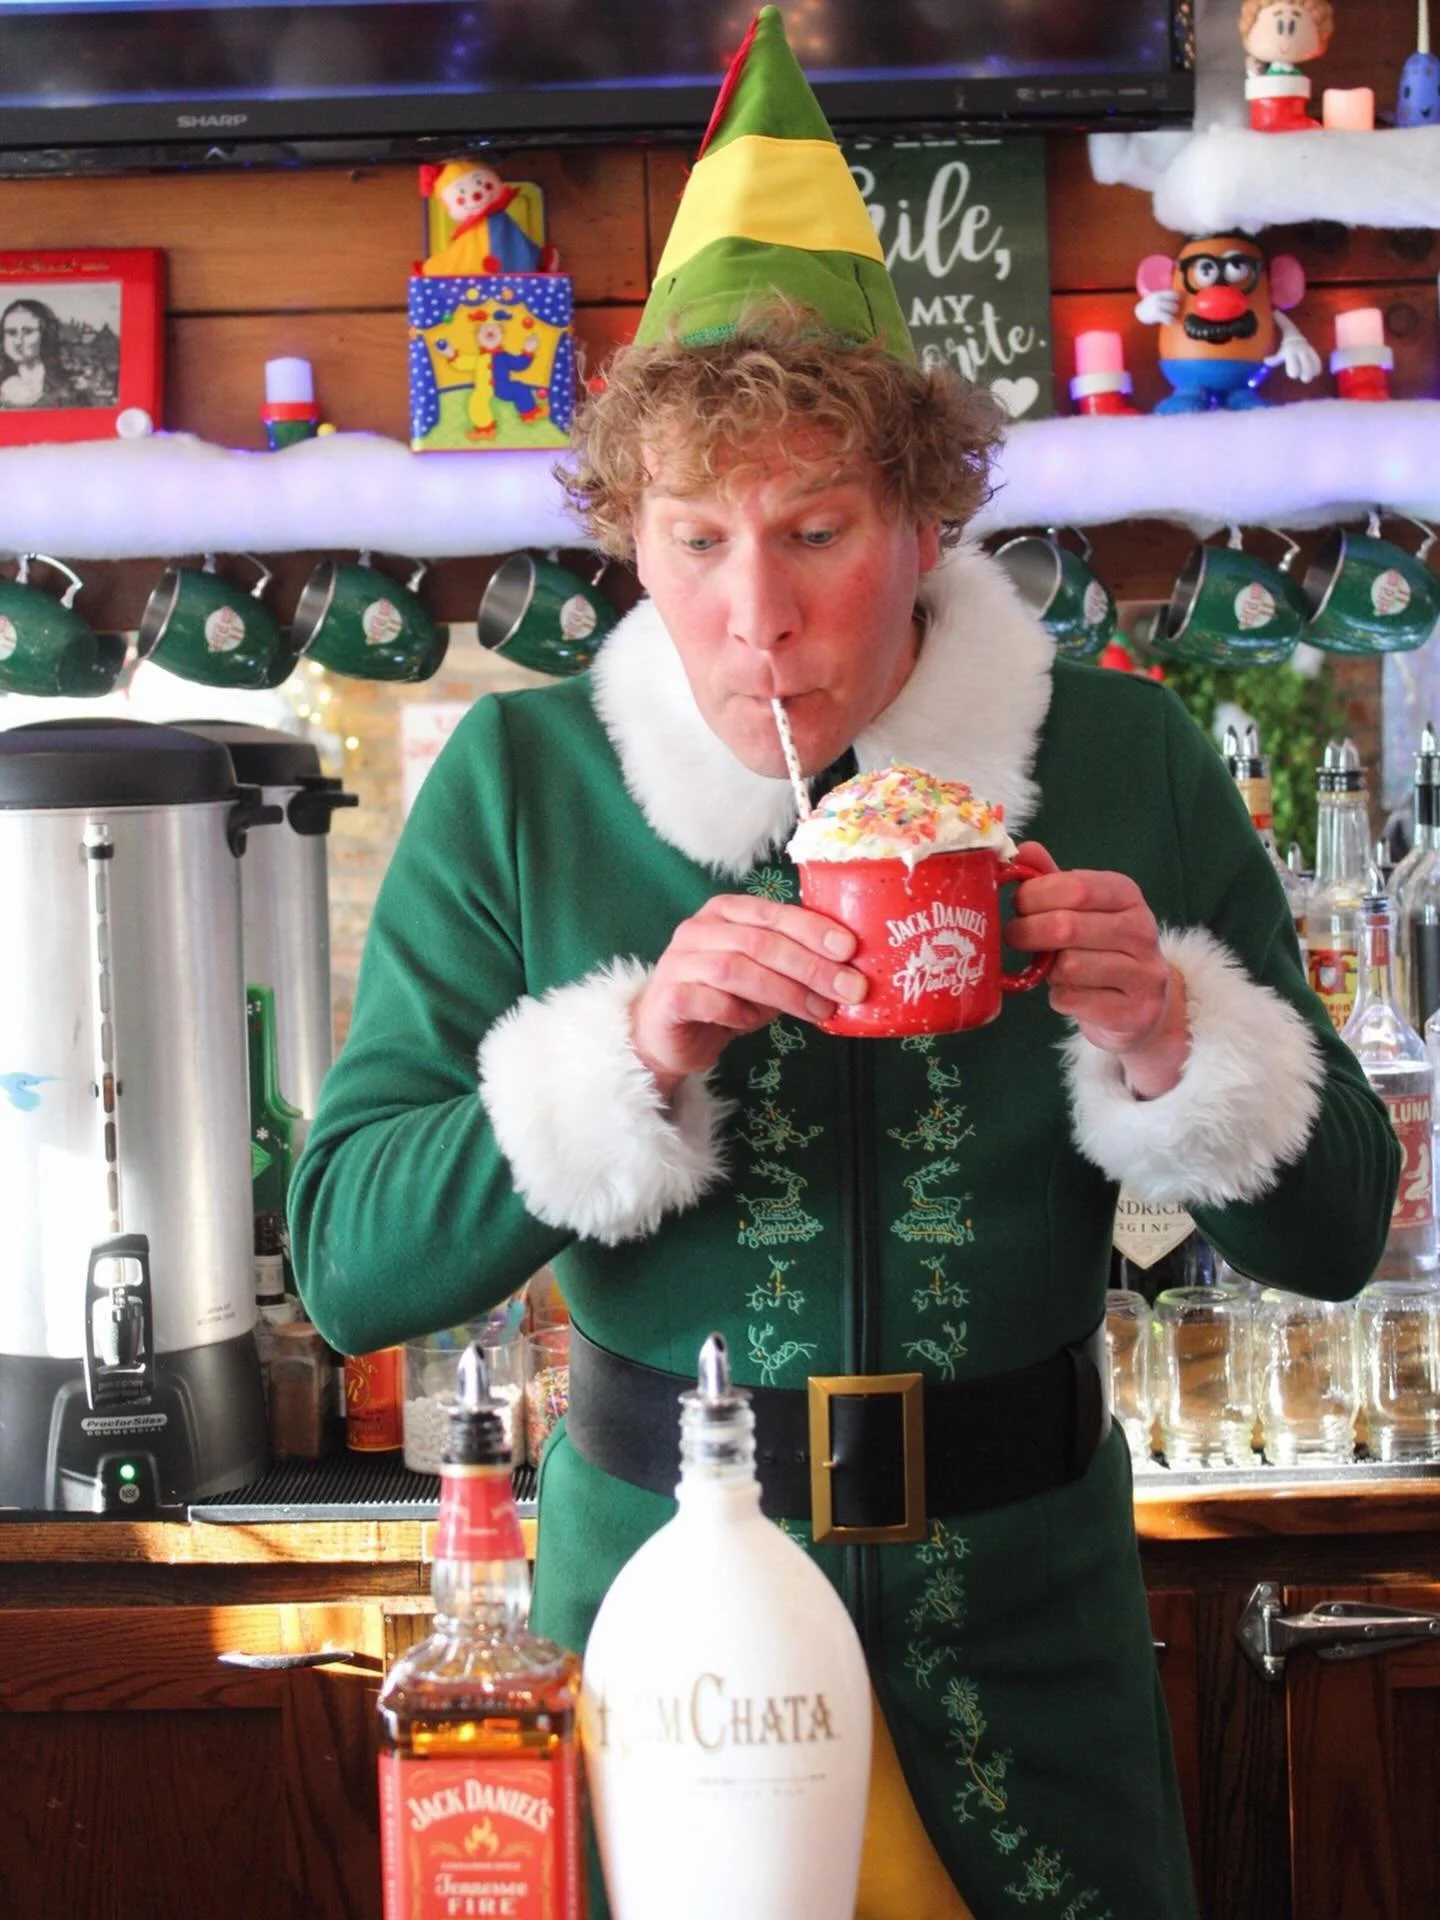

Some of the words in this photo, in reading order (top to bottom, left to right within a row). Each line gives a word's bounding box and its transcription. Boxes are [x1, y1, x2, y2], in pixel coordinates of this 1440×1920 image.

[177, 114, 247, 128] SHARP
[850, 160, 1011, 281] ile,
[909, 295, 973, 326] MY
[921, 301, 1046, 384] orite.
[885, 909, 932, 948] JACK
[1127, 1223, 1161, 1233] GIN
[596, 1672, 837, 1750] MCHATA
[408, 1787, 466, 1832] JACK
[464, 1778, 554, 1833] DANIEL'S
